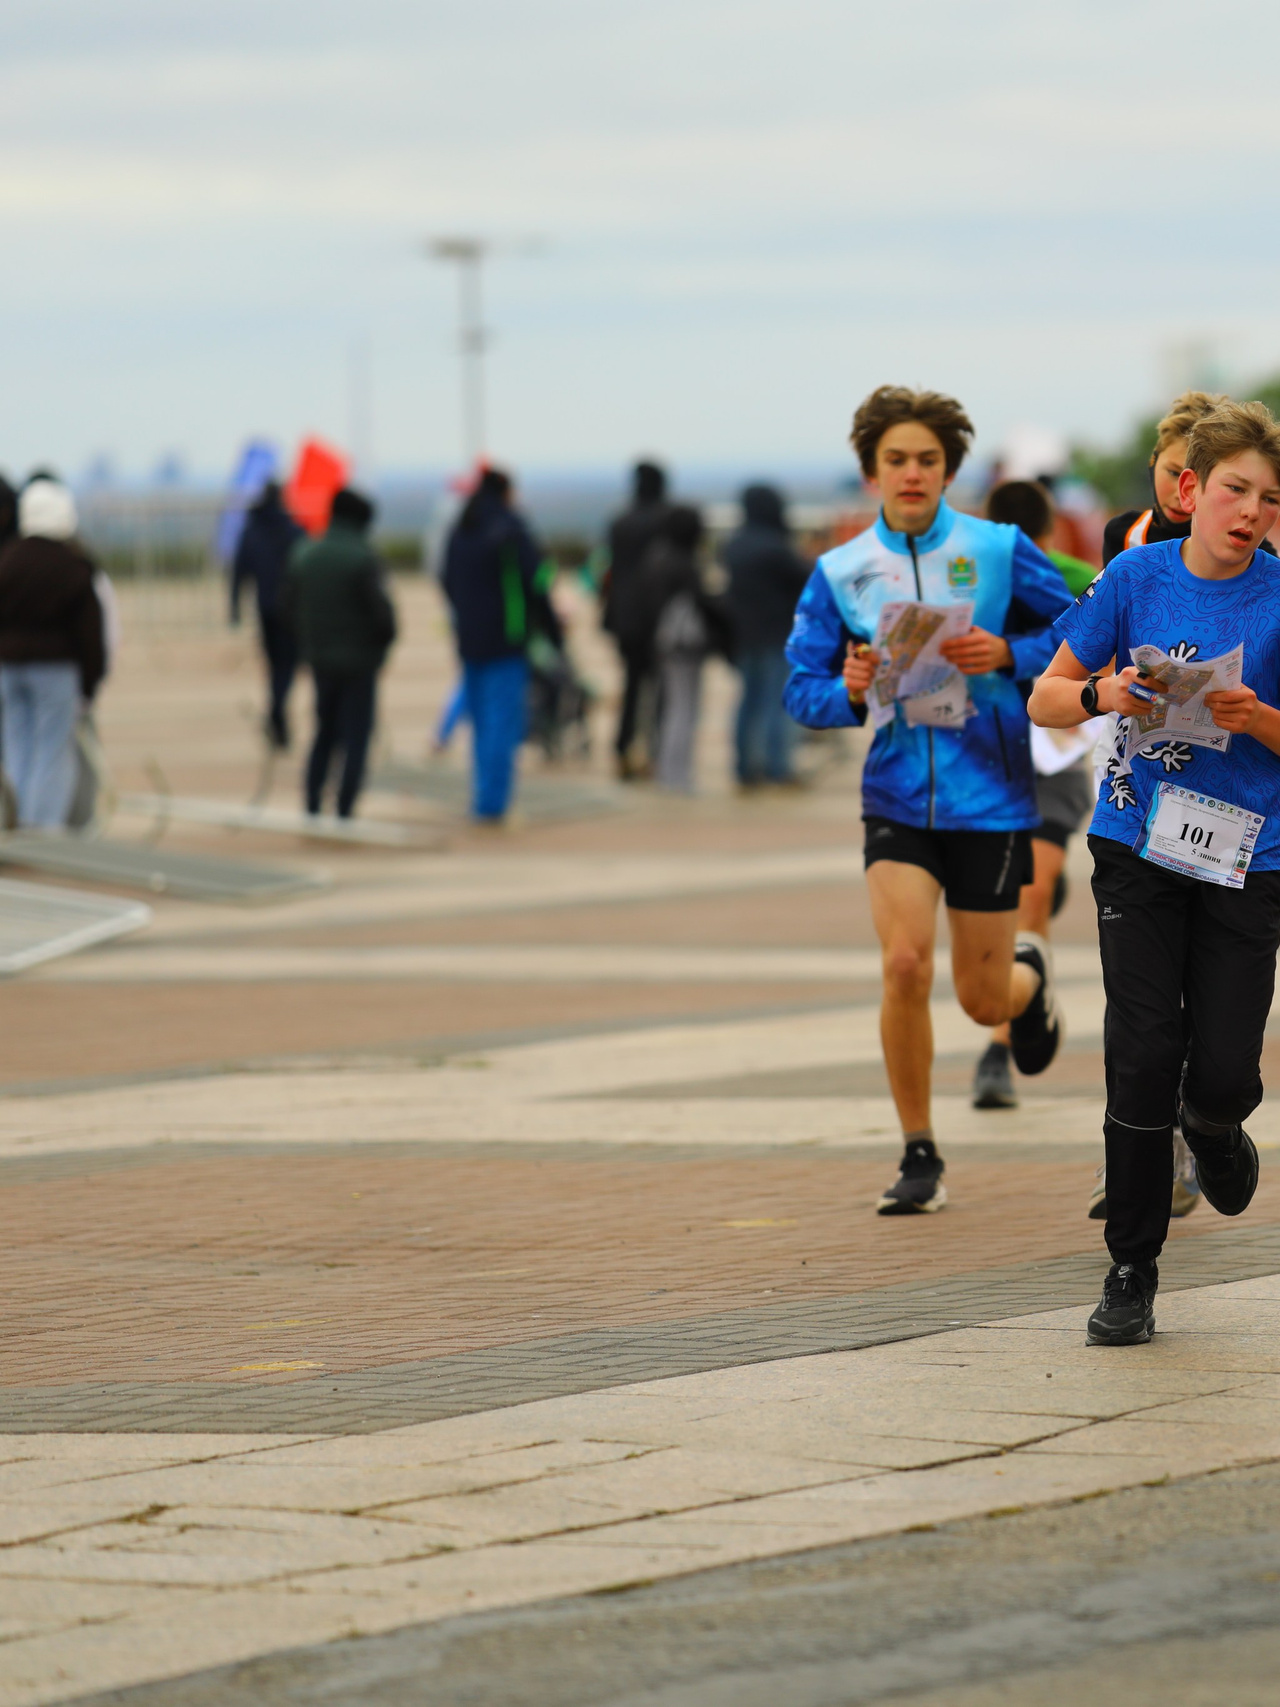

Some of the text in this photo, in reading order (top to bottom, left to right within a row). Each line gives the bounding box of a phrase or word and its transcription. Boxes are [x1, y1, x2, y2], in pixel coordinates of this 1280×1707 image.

[1178, 823, 1214, 849] 101
[1190, 848, 1197, 856] 5
[1176, 860, 1196, 871] РОССИИ
[1183, 868, 1220, 883] СОРЕВНОВАНИЯ
